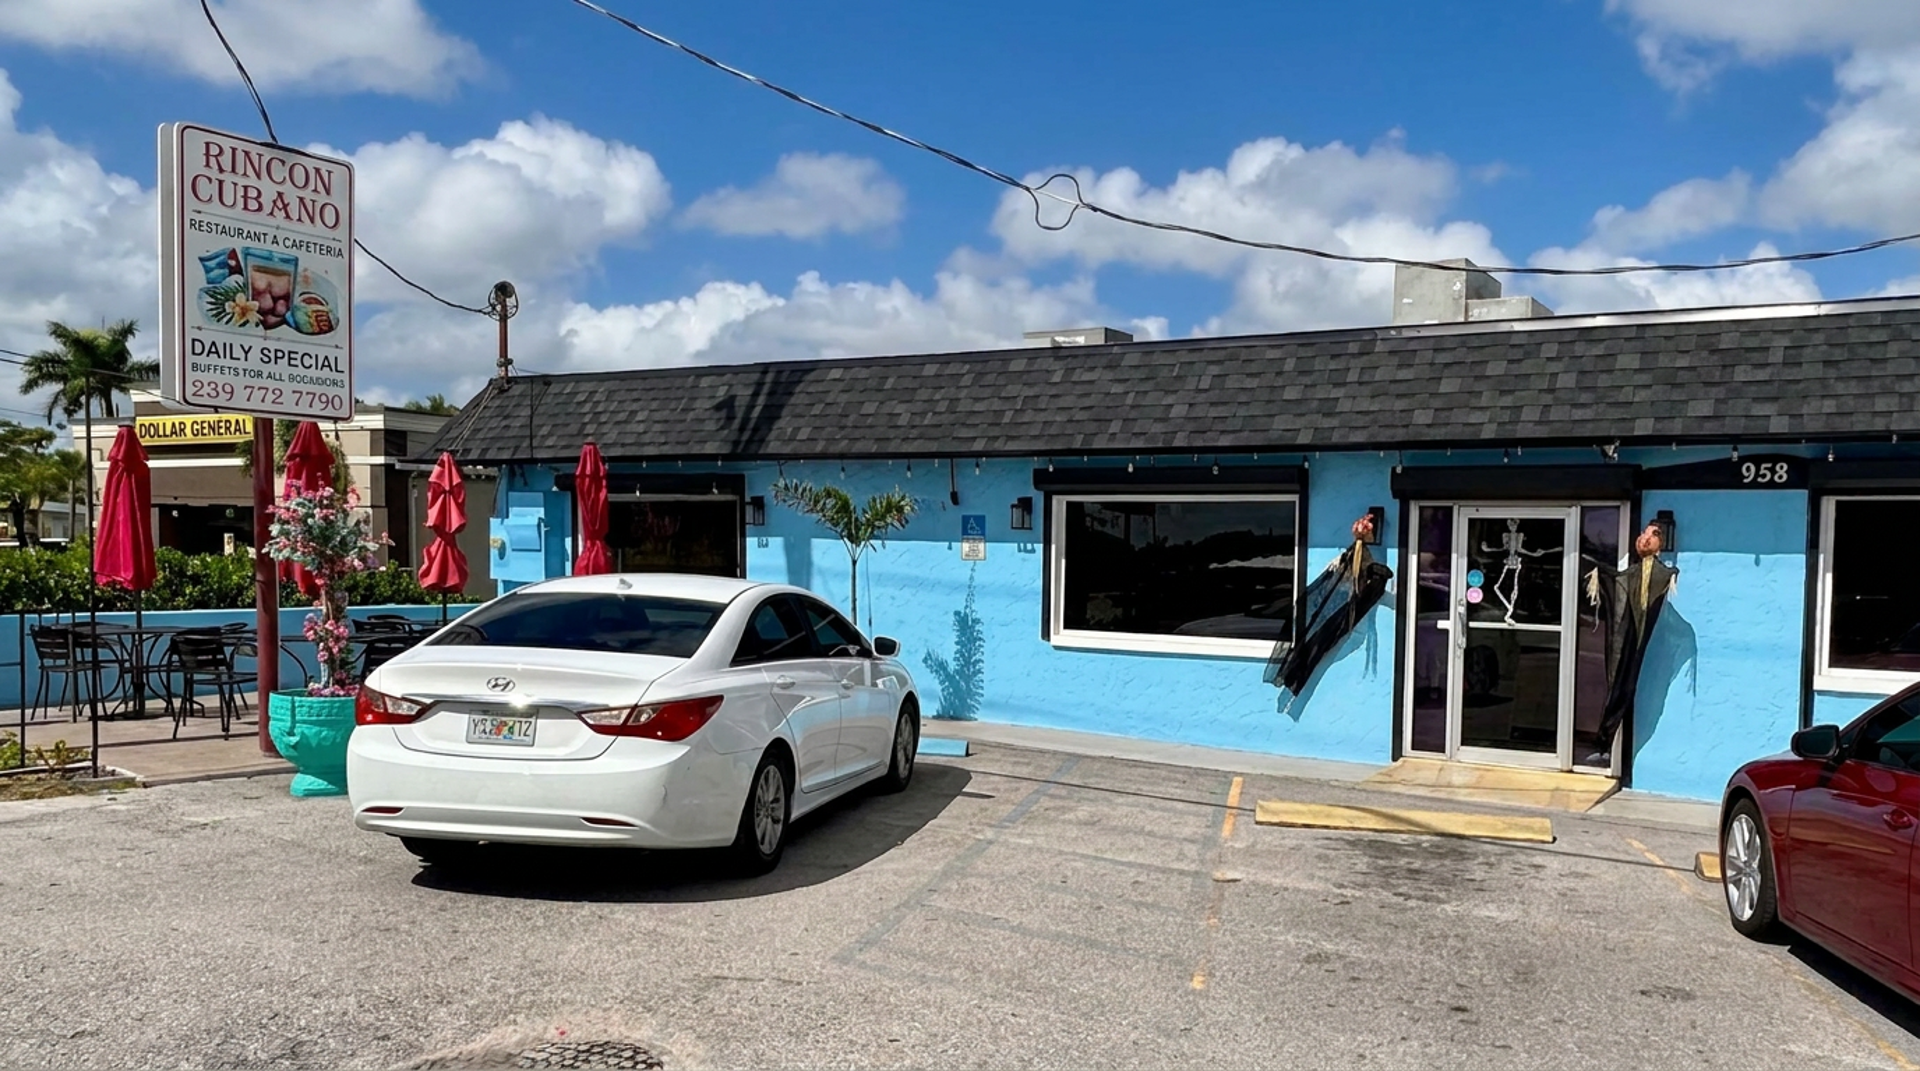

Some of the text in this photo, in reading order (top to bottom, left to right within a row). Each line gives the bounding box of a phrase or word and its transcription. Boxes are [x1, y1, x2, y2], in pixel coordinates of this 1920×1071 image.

[203, 141, 334, 196] RINCON
[191, 173, 341, 231] CUBANO
[189, 218, 268, 244] RESTAURANT
[282, 236, 344, 259] CAFETERIA
[190, 338, 345, 373] DAILY SPECIAL
[191, 362, 239, 377] BUFFETS
[266, 372, 285, 382] ALL
[191, 379, 344, 411] 239 772 7790
[139, 418, 251, 438] DOLLAR GENERAL
[1741, 462, 1788, 483] 958
